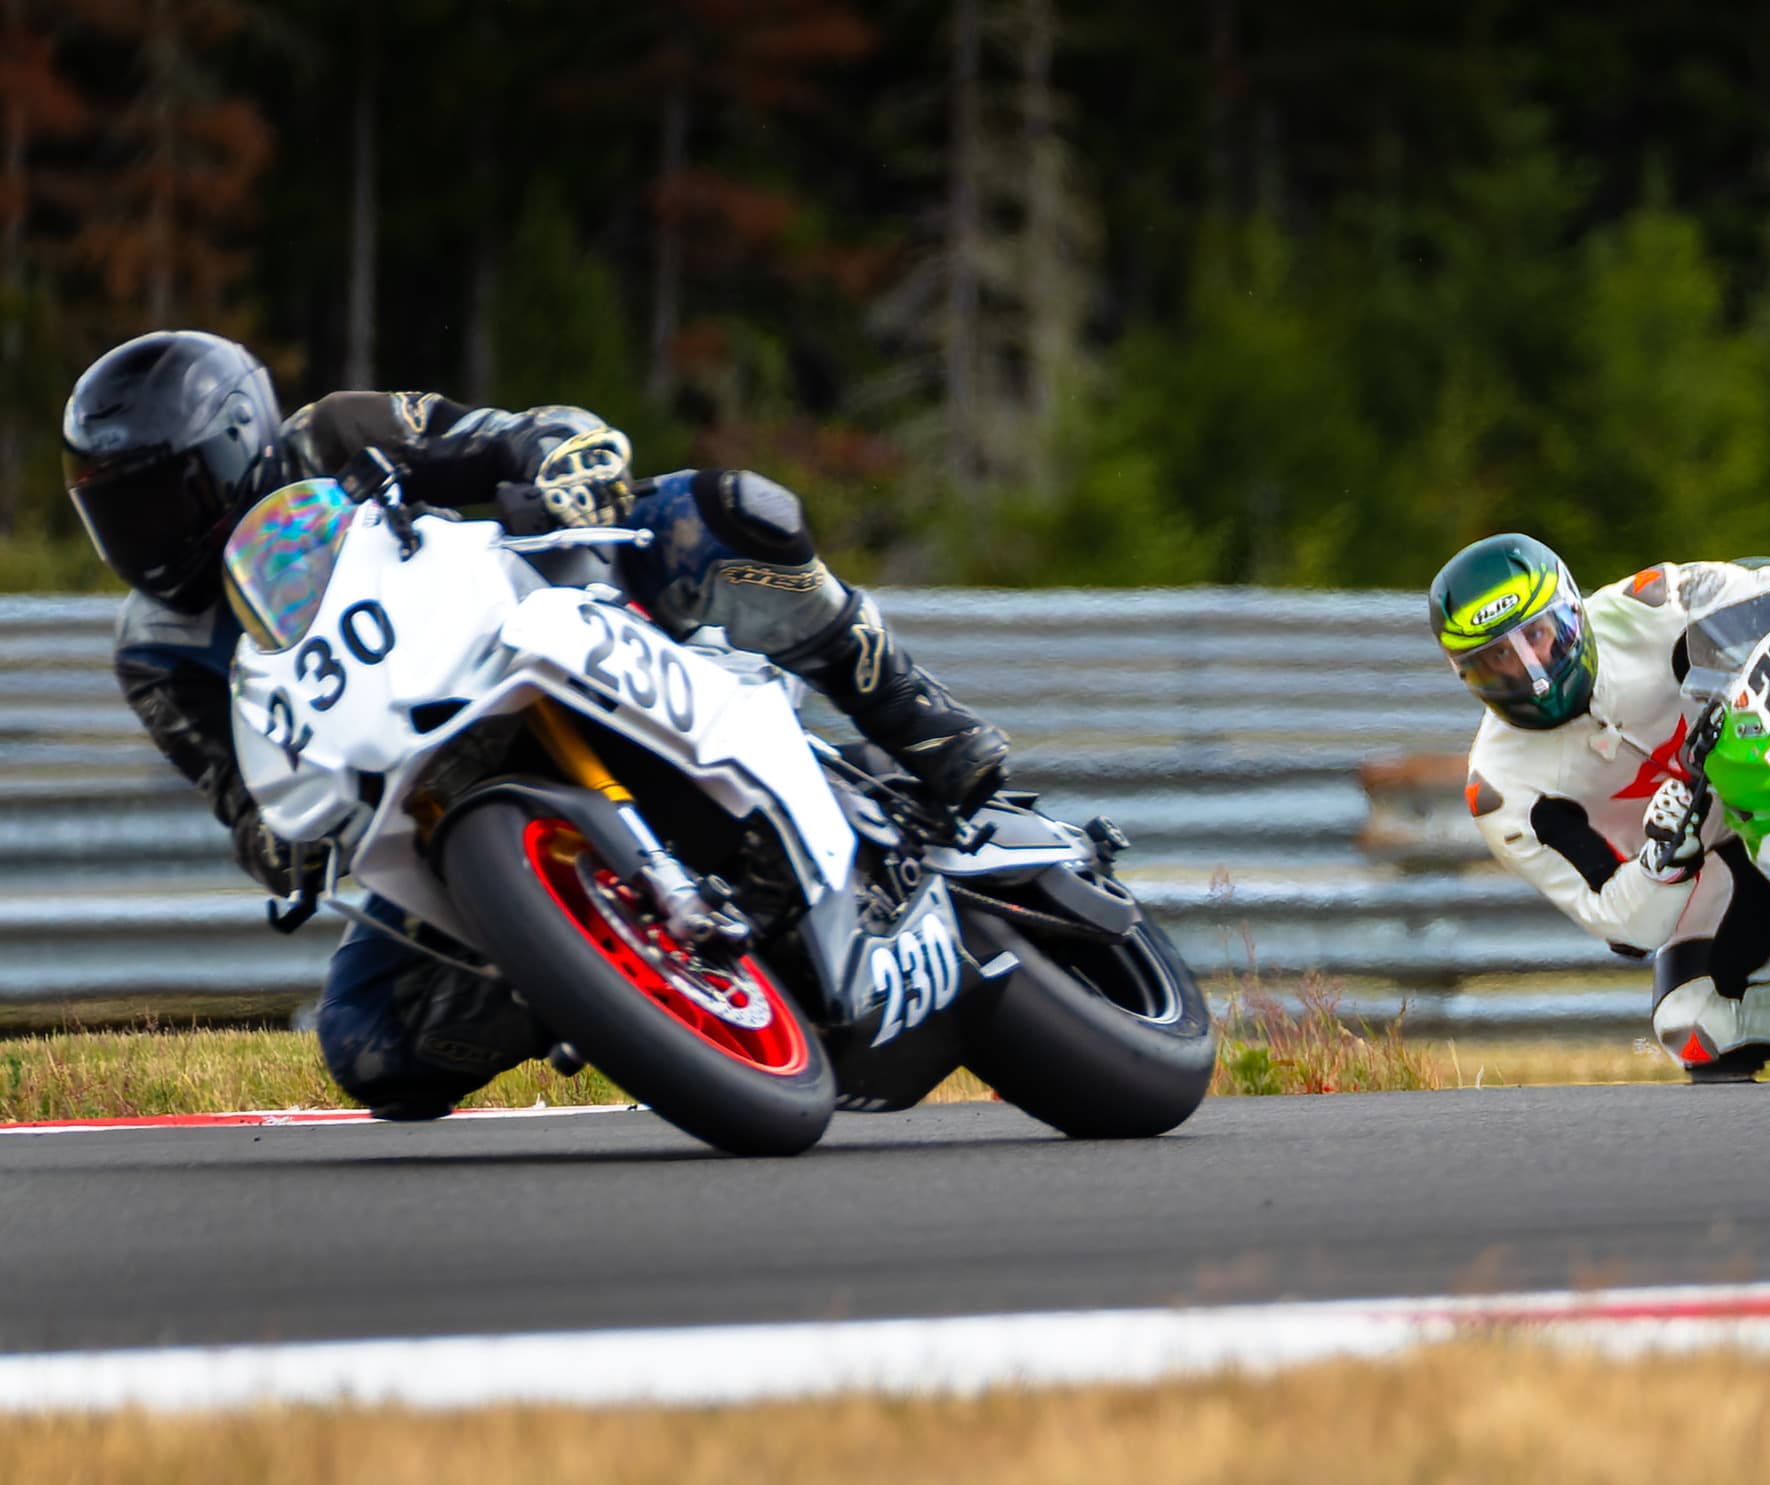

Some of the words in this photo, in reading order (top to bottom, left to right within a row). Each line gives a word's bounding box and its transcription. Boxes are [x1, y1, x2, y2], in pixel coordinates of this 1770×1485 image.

[577, 603, 694, 733] 230
[1475, 593, 1516, 625] HJC
[264, 598, 396, 772] 230
[870, 913, 959, 1049] 230
